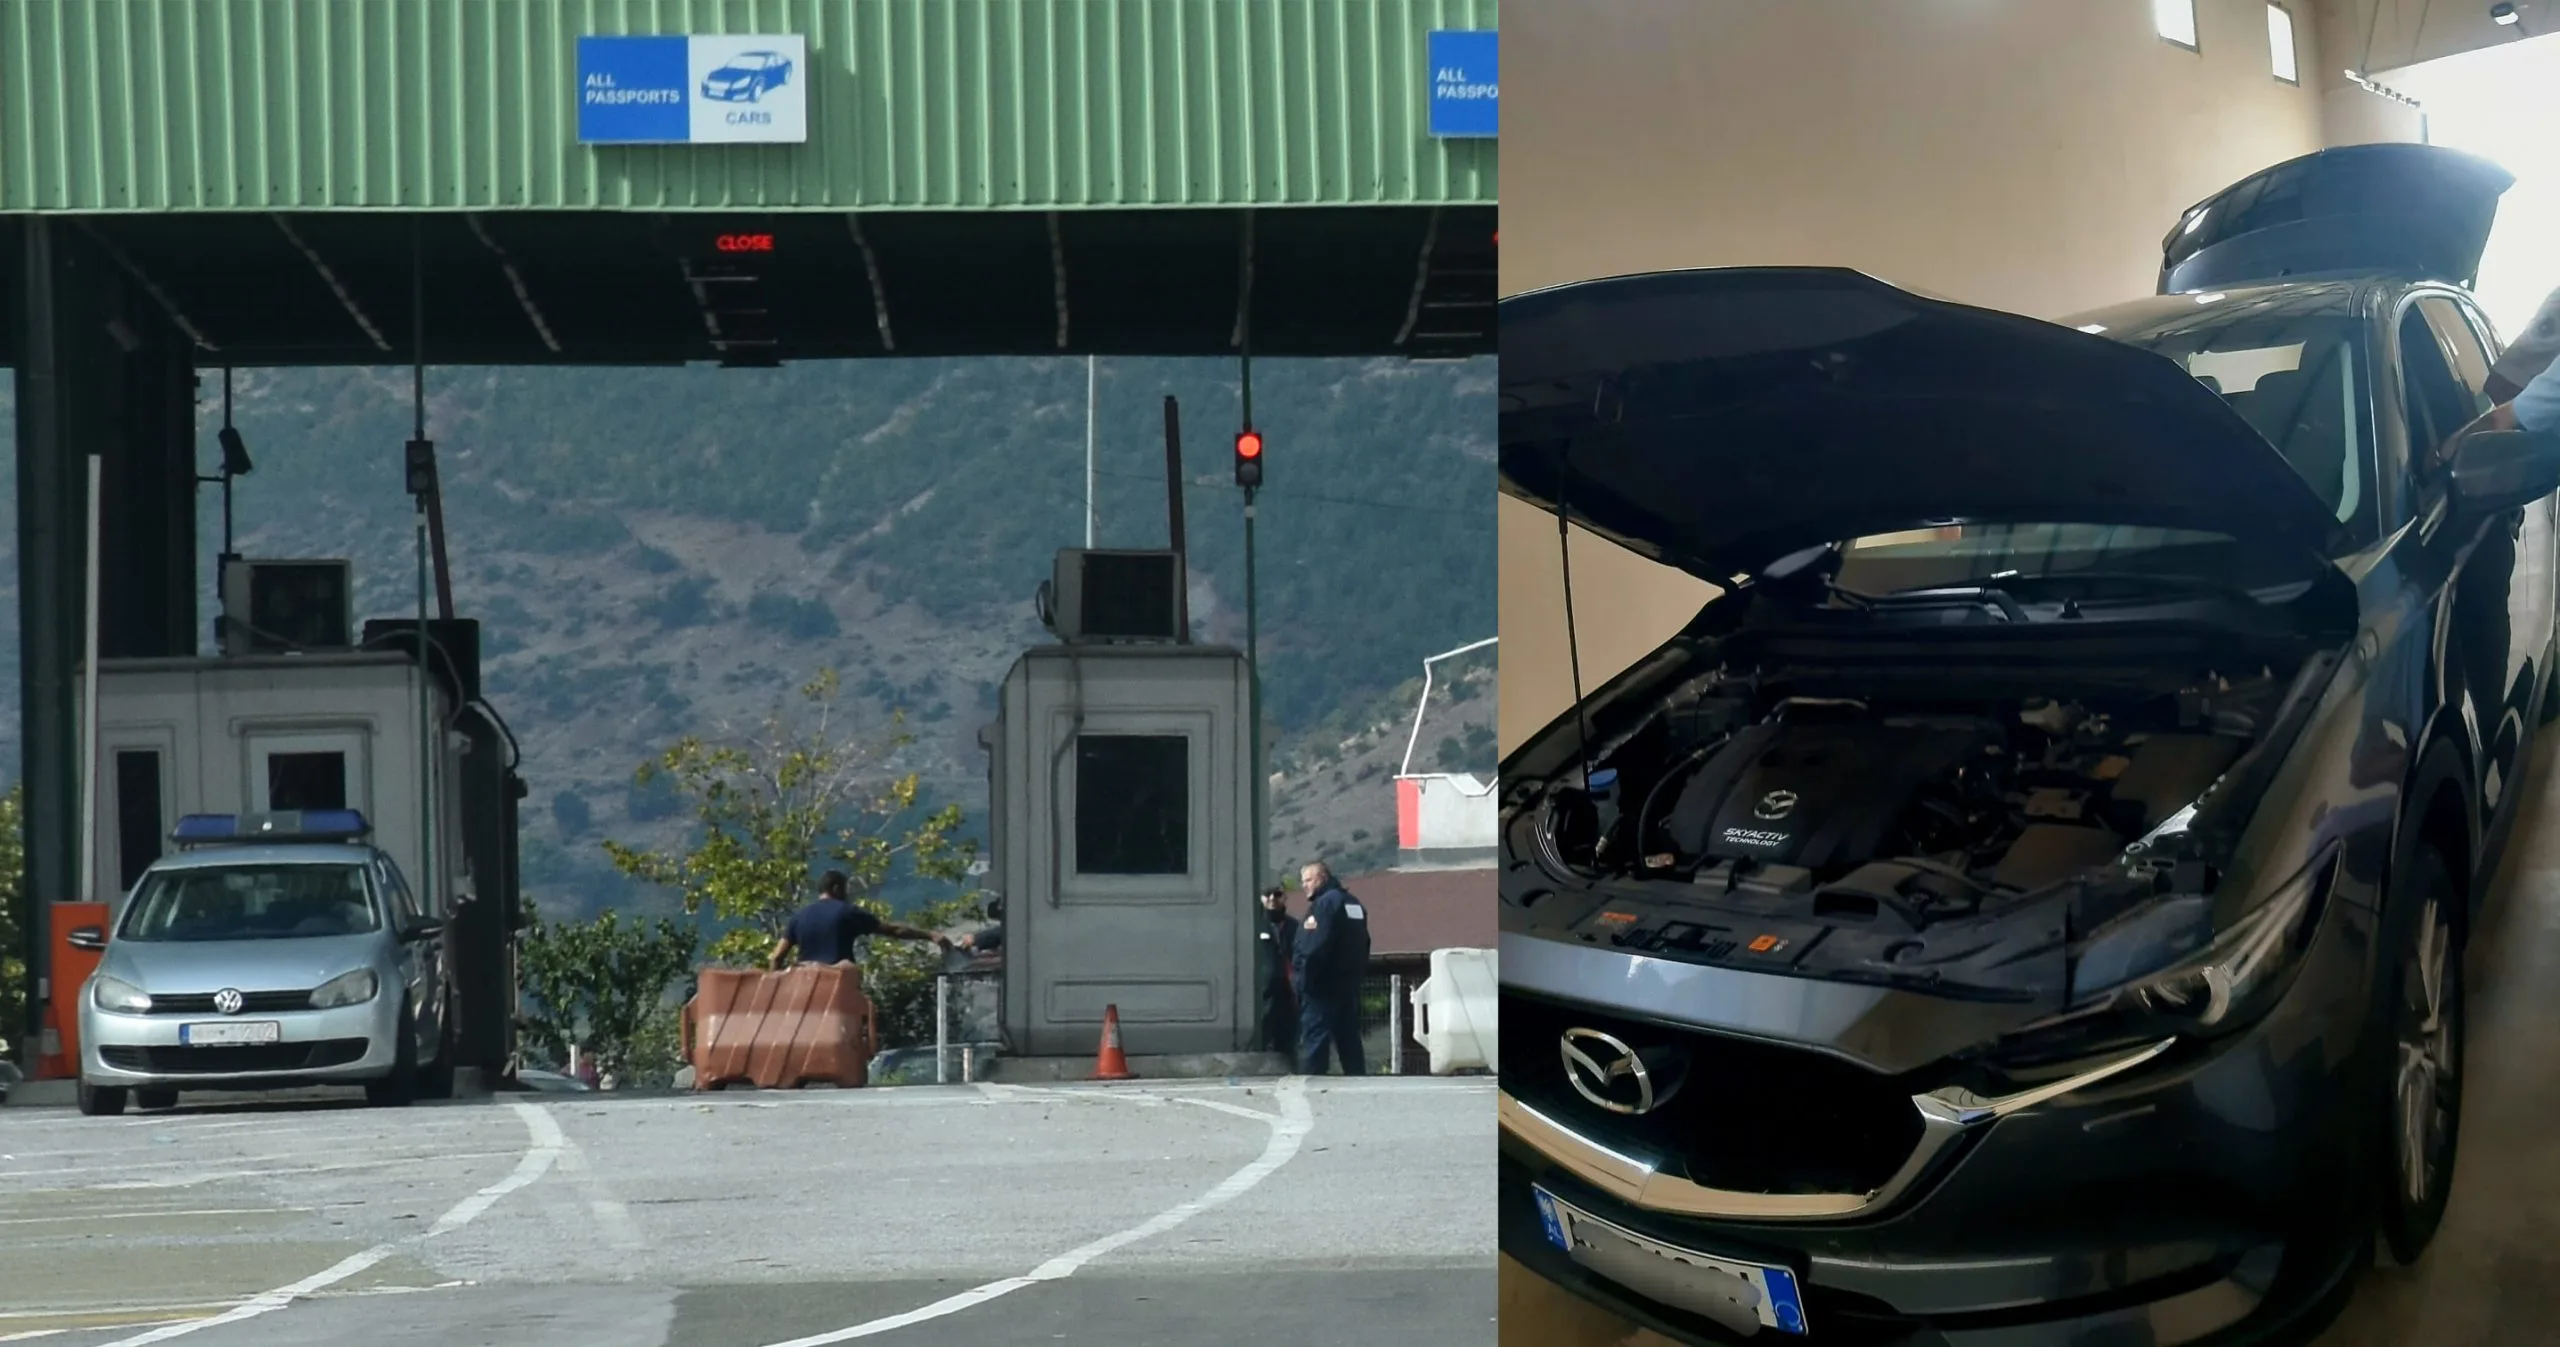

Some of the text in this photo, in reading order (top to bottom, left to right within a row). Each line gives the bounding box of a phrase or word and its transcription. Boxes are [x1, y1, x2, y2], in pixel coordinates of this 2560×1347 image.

[585, 73, 616, 88] ALL
[1436, 66, 1466, 82] ALL
[586, 89, 680, 105] PASSPORTS
[725, 111, 772, 125] CARS
[716, 233, 774, 251] CLOSE
[1723, 828, 1789, 841] SKYACTIV
[1725, 836, 1780, 847] TECHNOLOGY
